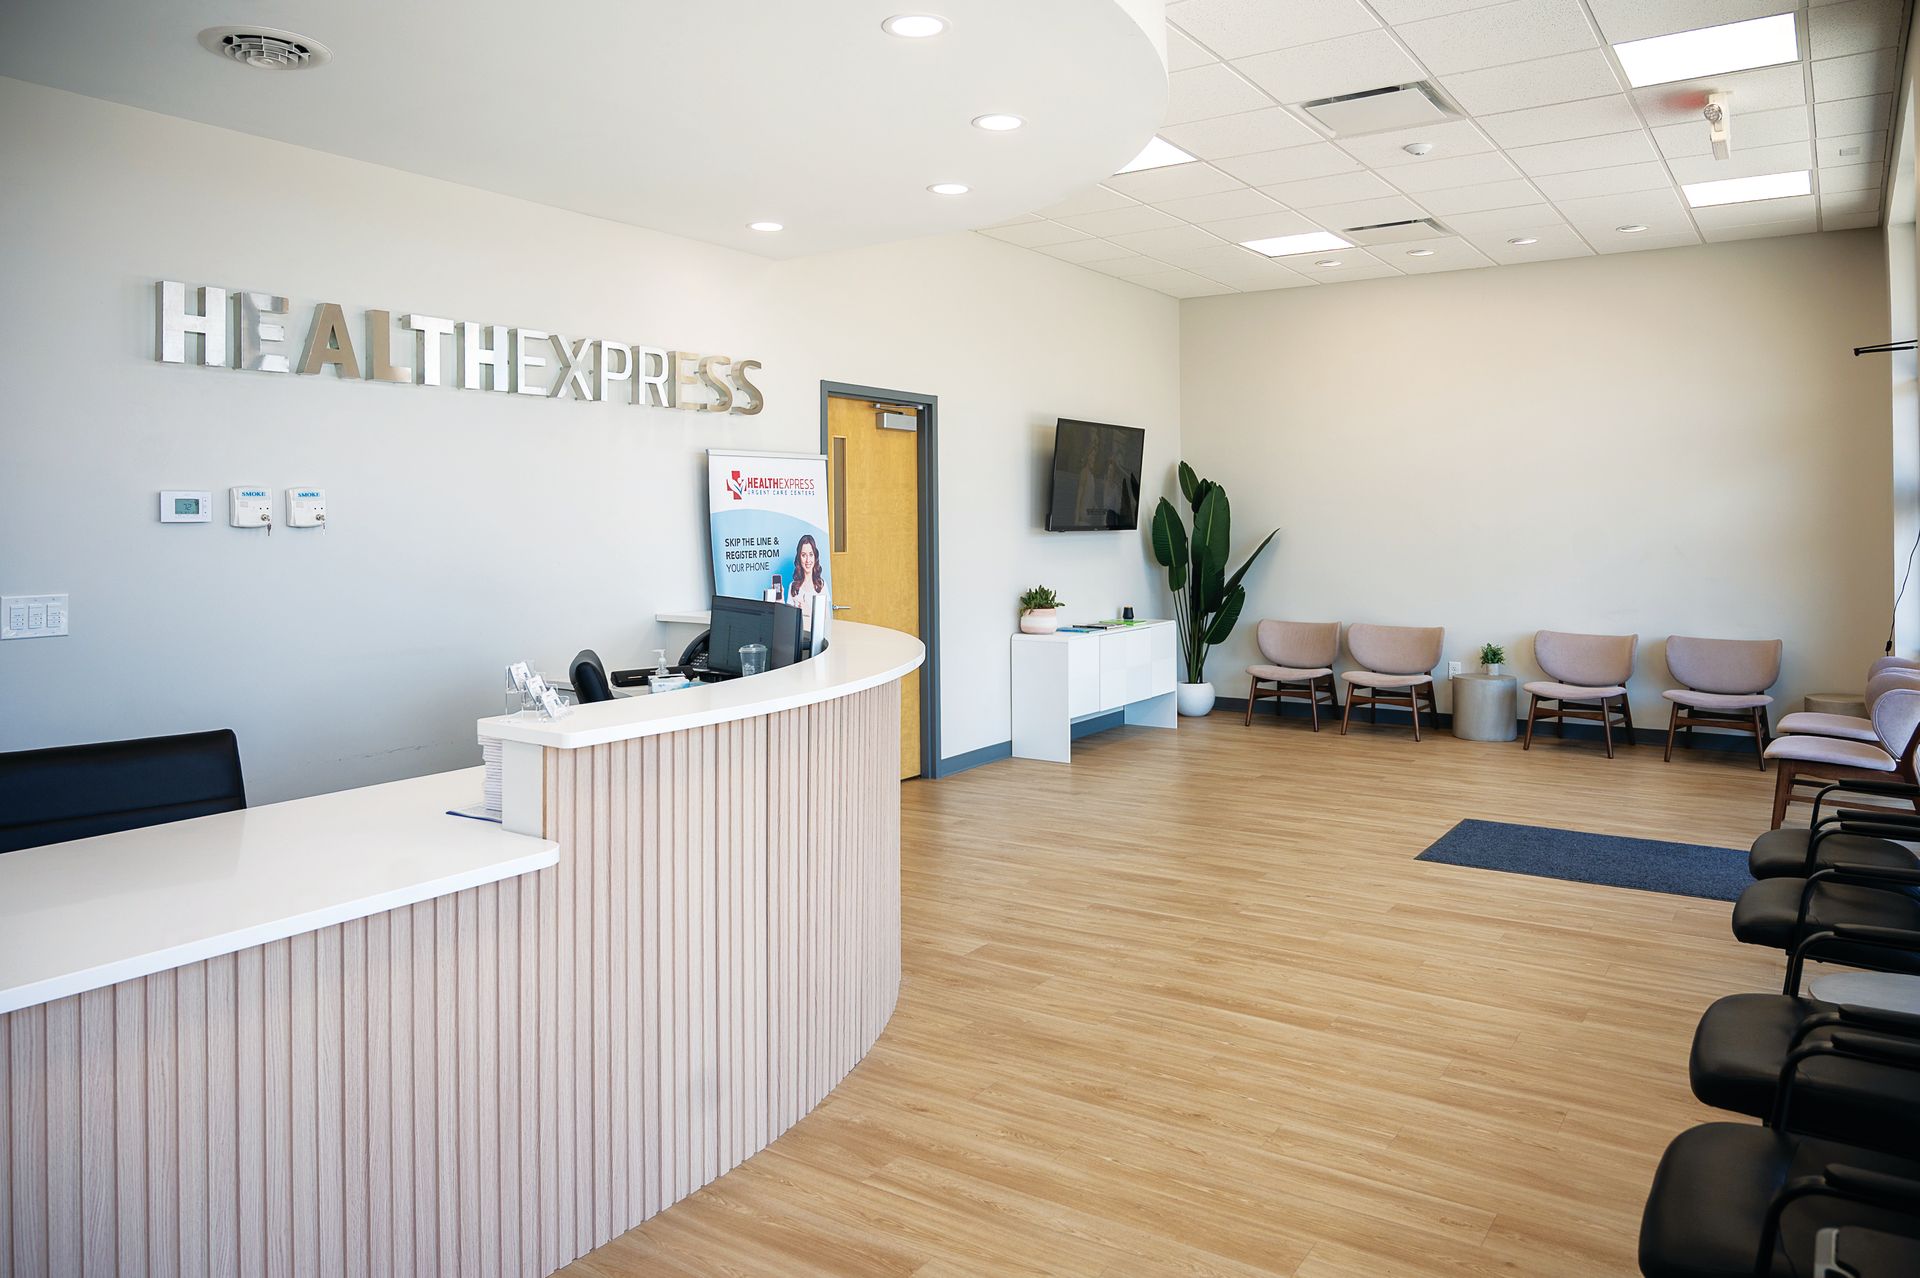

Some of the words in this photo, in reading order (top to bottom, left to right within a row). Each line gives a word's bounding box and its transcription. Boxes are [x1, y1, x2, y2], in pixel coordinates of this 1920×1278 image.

[155, 280, 763, 416] HEALTHEXPRESS
[747, 477, 815, 489] HEALTHEXPRESS
[725, 538, 741, 547] SKIP
[742, 537, 755, 546] THE
[756, 537, 772, 546] LINE
[773, 536, 780, 545] &
[725, 550, 758, 560] REGISTER
[759, 549, 780, 558] FROM
[726, 563, 745, 573] YOUR
[745, 561, 770, 571] PHONE
